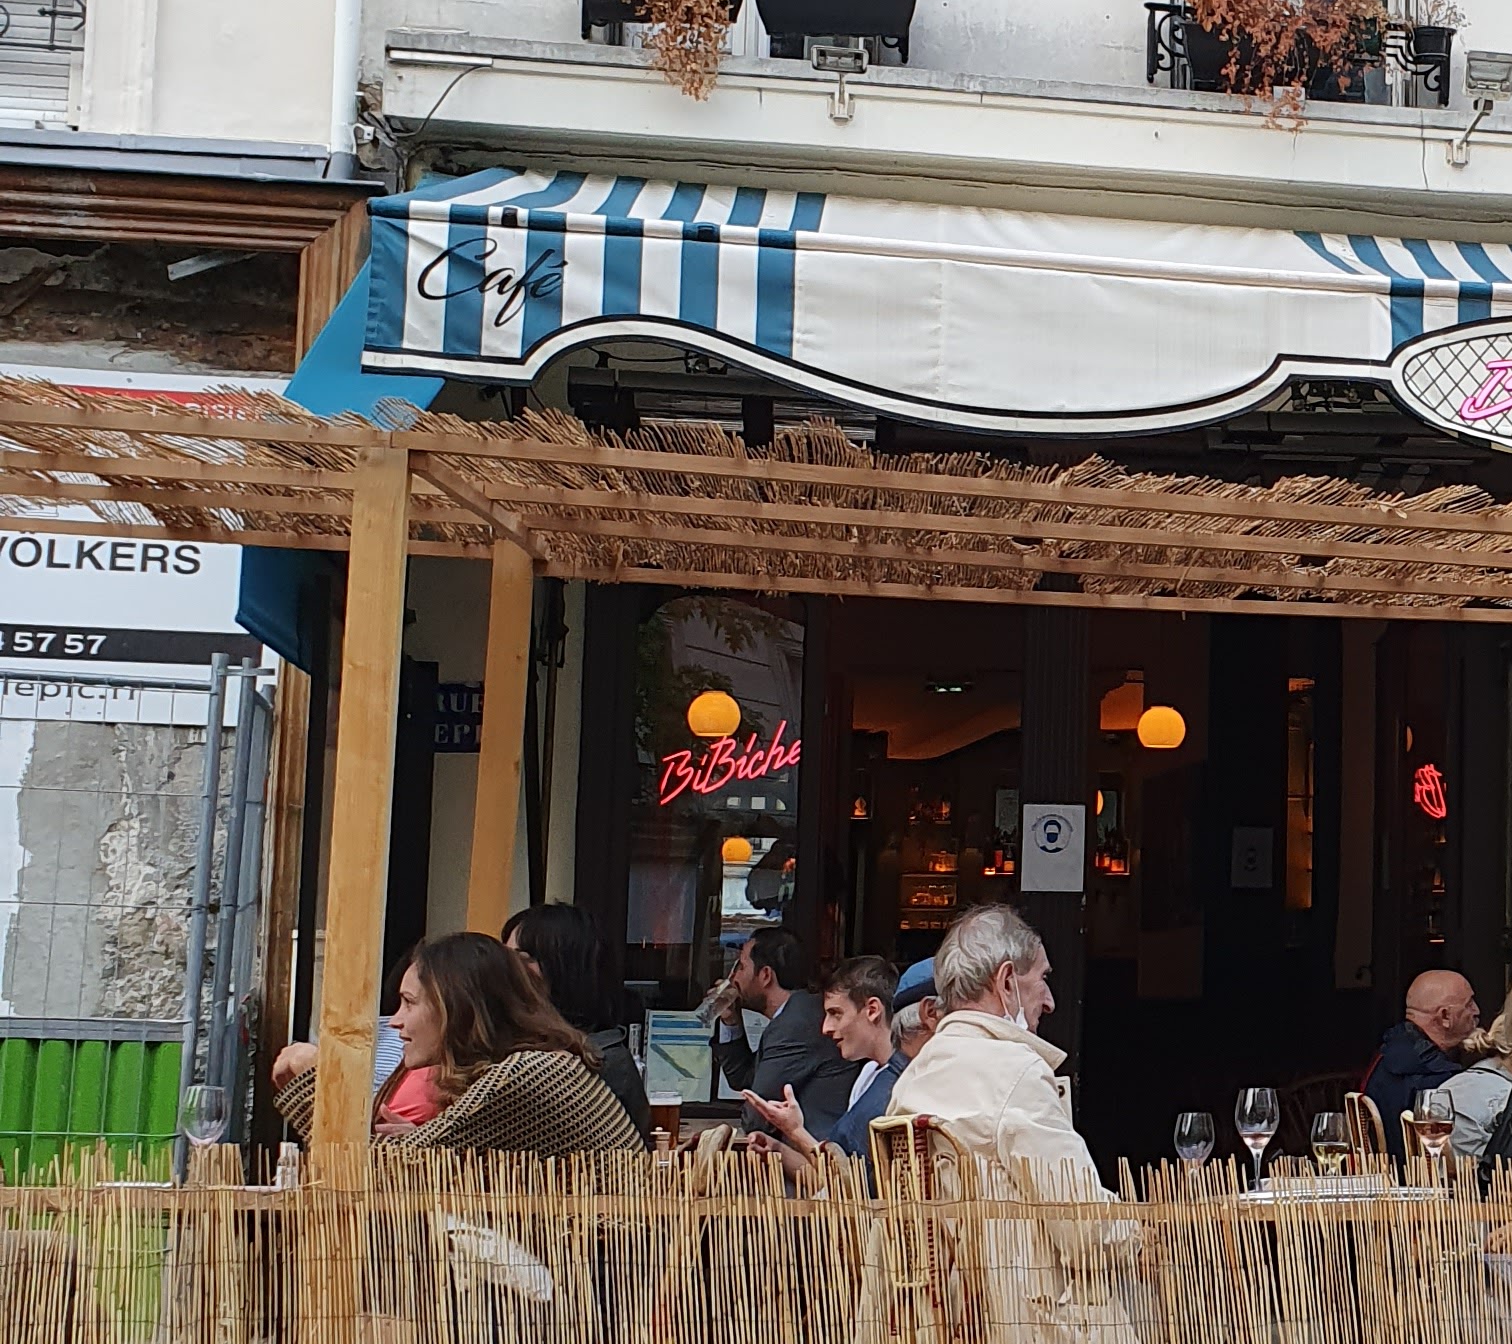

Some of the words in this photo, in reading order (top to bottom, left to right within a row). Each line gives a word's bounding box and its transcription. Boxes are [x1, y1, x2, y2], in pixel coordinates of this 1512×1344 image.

[416, 236, 568, 328] Café
[0, 531, 202, 575] ÖLKERS
[12, 631, 57, 653] 57
[64, 633, 107, 655] 57
[659, 719, 802, 806] BiBiche
